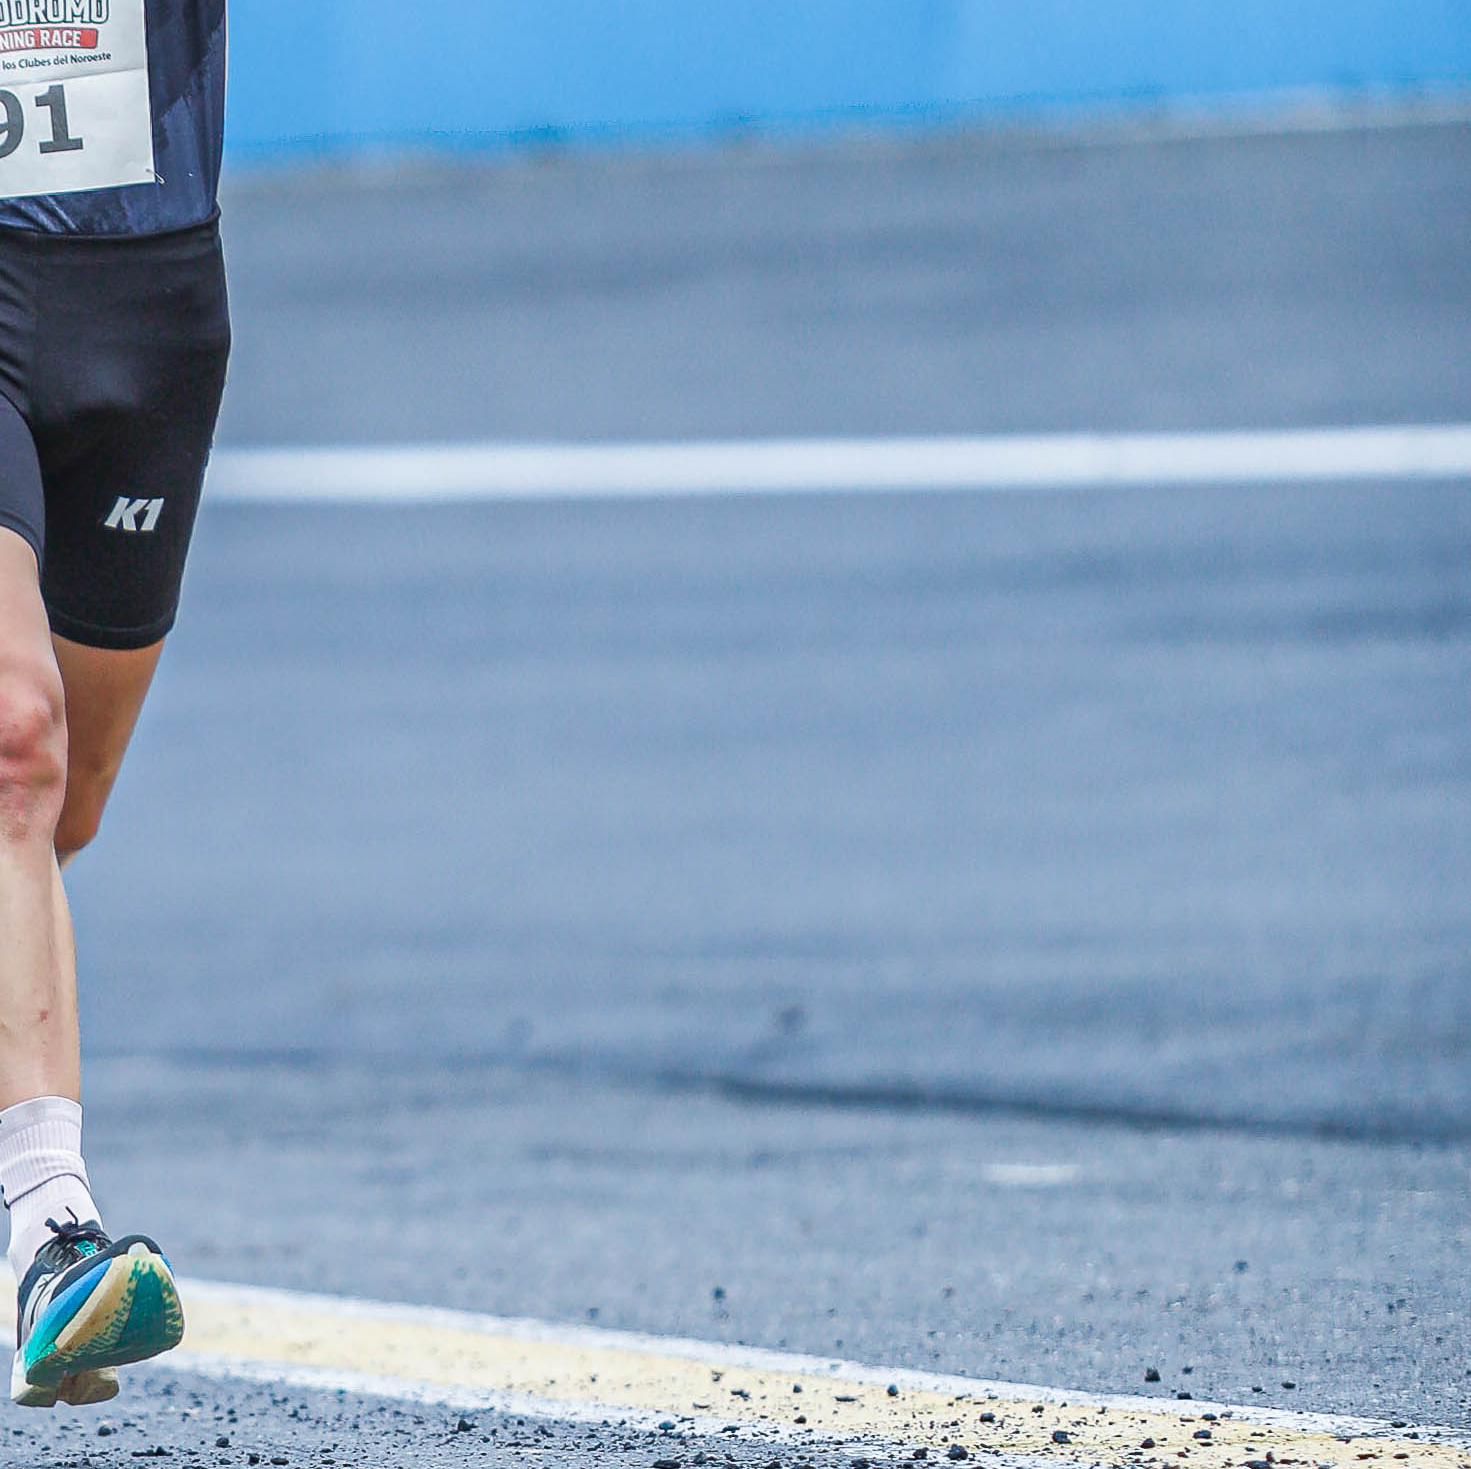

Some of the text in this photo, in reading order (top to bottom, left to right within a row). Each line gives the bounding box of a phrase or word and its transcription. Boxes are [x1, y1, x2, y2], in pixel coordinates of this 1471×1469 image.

[40, 30, 82, 46] RACE
[2, 60, 16, 70] los
[19, 56, 51, 68] Clubes
[53, 54, 69, 65] del
[71, 51, 112, 63] Noroeste
[104, 496, 164, 531] K1
